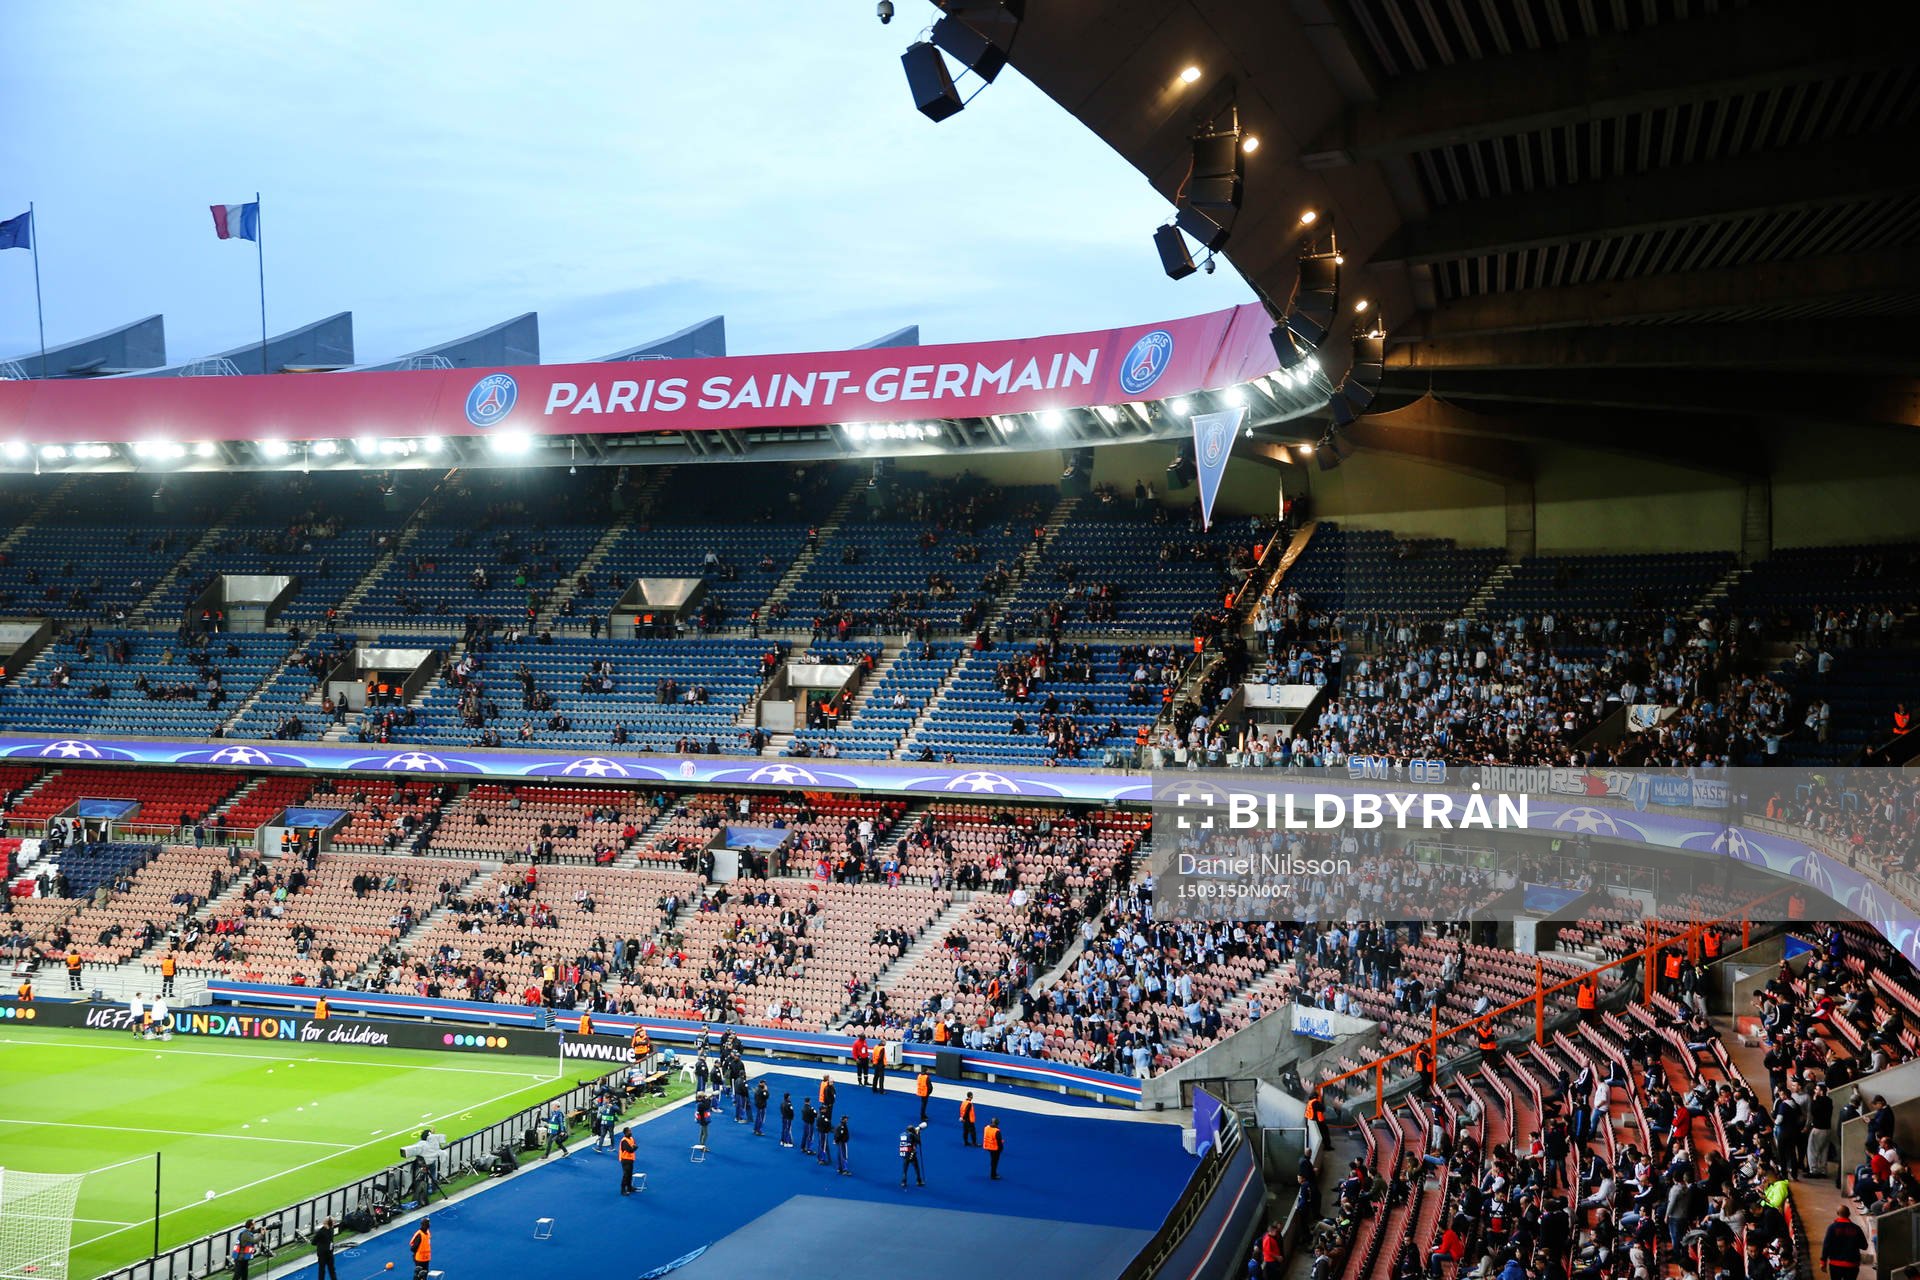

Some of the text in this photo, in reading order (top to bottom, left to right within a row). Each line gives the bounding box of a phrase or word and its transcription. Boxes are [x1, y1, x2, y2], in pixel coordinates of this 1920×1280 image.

[480, 377, 512, 389] PARIS
[544, 348, 1099, 415] PARIS SAINT-GERMAIN
[1348, 755, 1446, 784] SM 03
[301, 1021, 325, 1042] for
[328, 1024, 389, 1045] children
